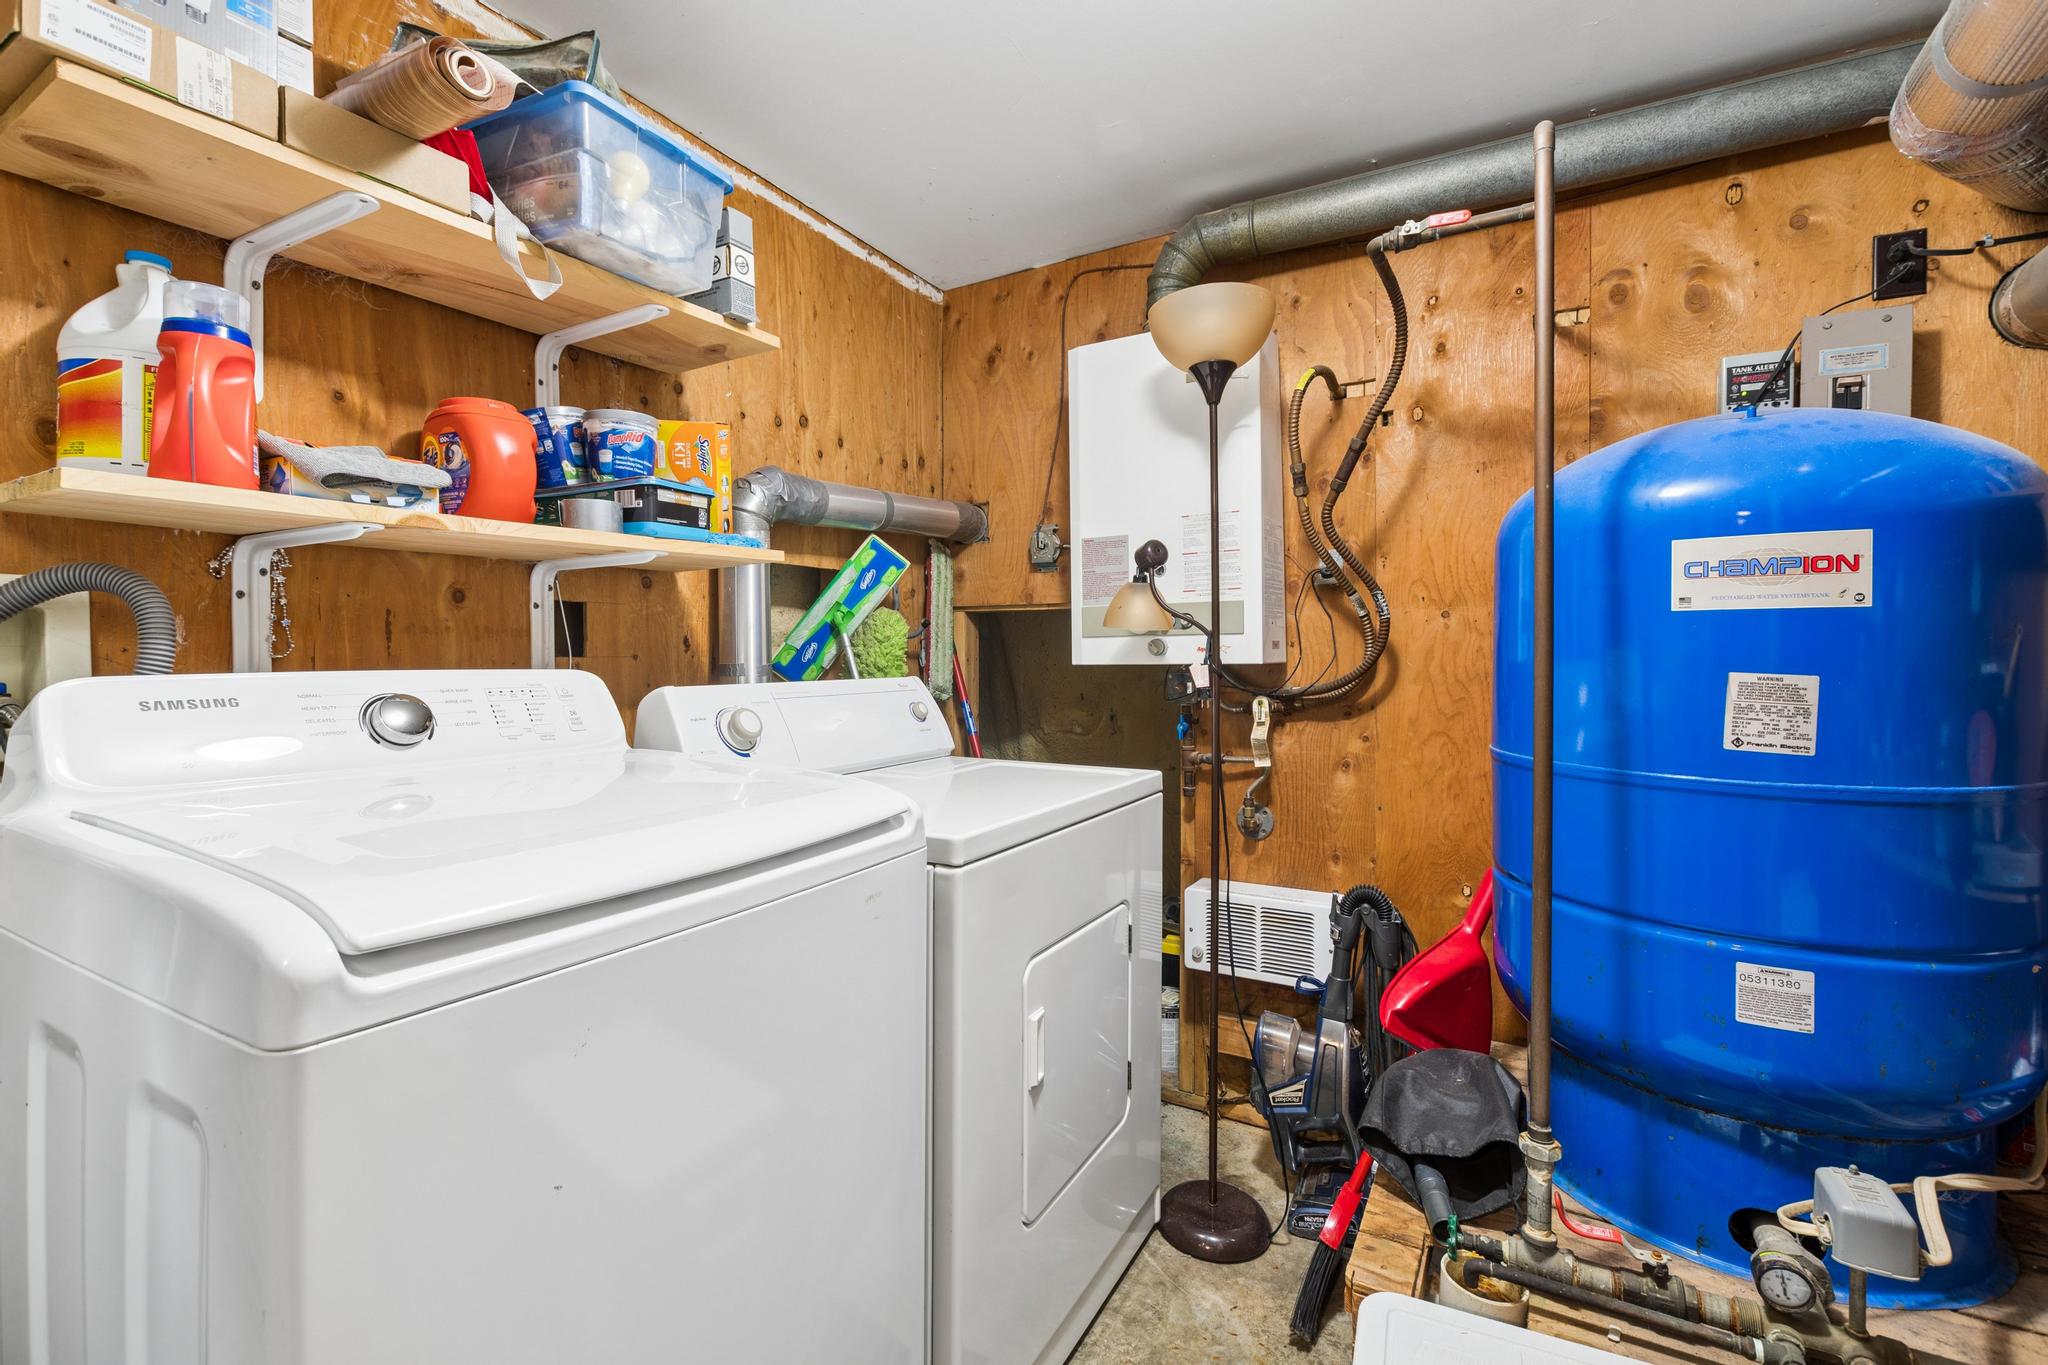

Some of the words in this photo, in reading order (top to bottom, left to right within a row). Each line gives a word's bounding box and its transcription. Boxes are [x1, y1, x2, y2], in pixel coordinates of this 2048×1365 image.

[1732, 366, 1753, 374] TANK
[607, 432, 644, 445] DampRid
[424, 447, 438, 466] Tide
[674, 442, 686, 469] KIT
[697, 435, 710, 475] Swiffer
[1683, 554, 1861, 579] CHAMPION
[138, 697, 240, 712] SAMSUNG
[1739, 973, 1801, 990] 05311380
